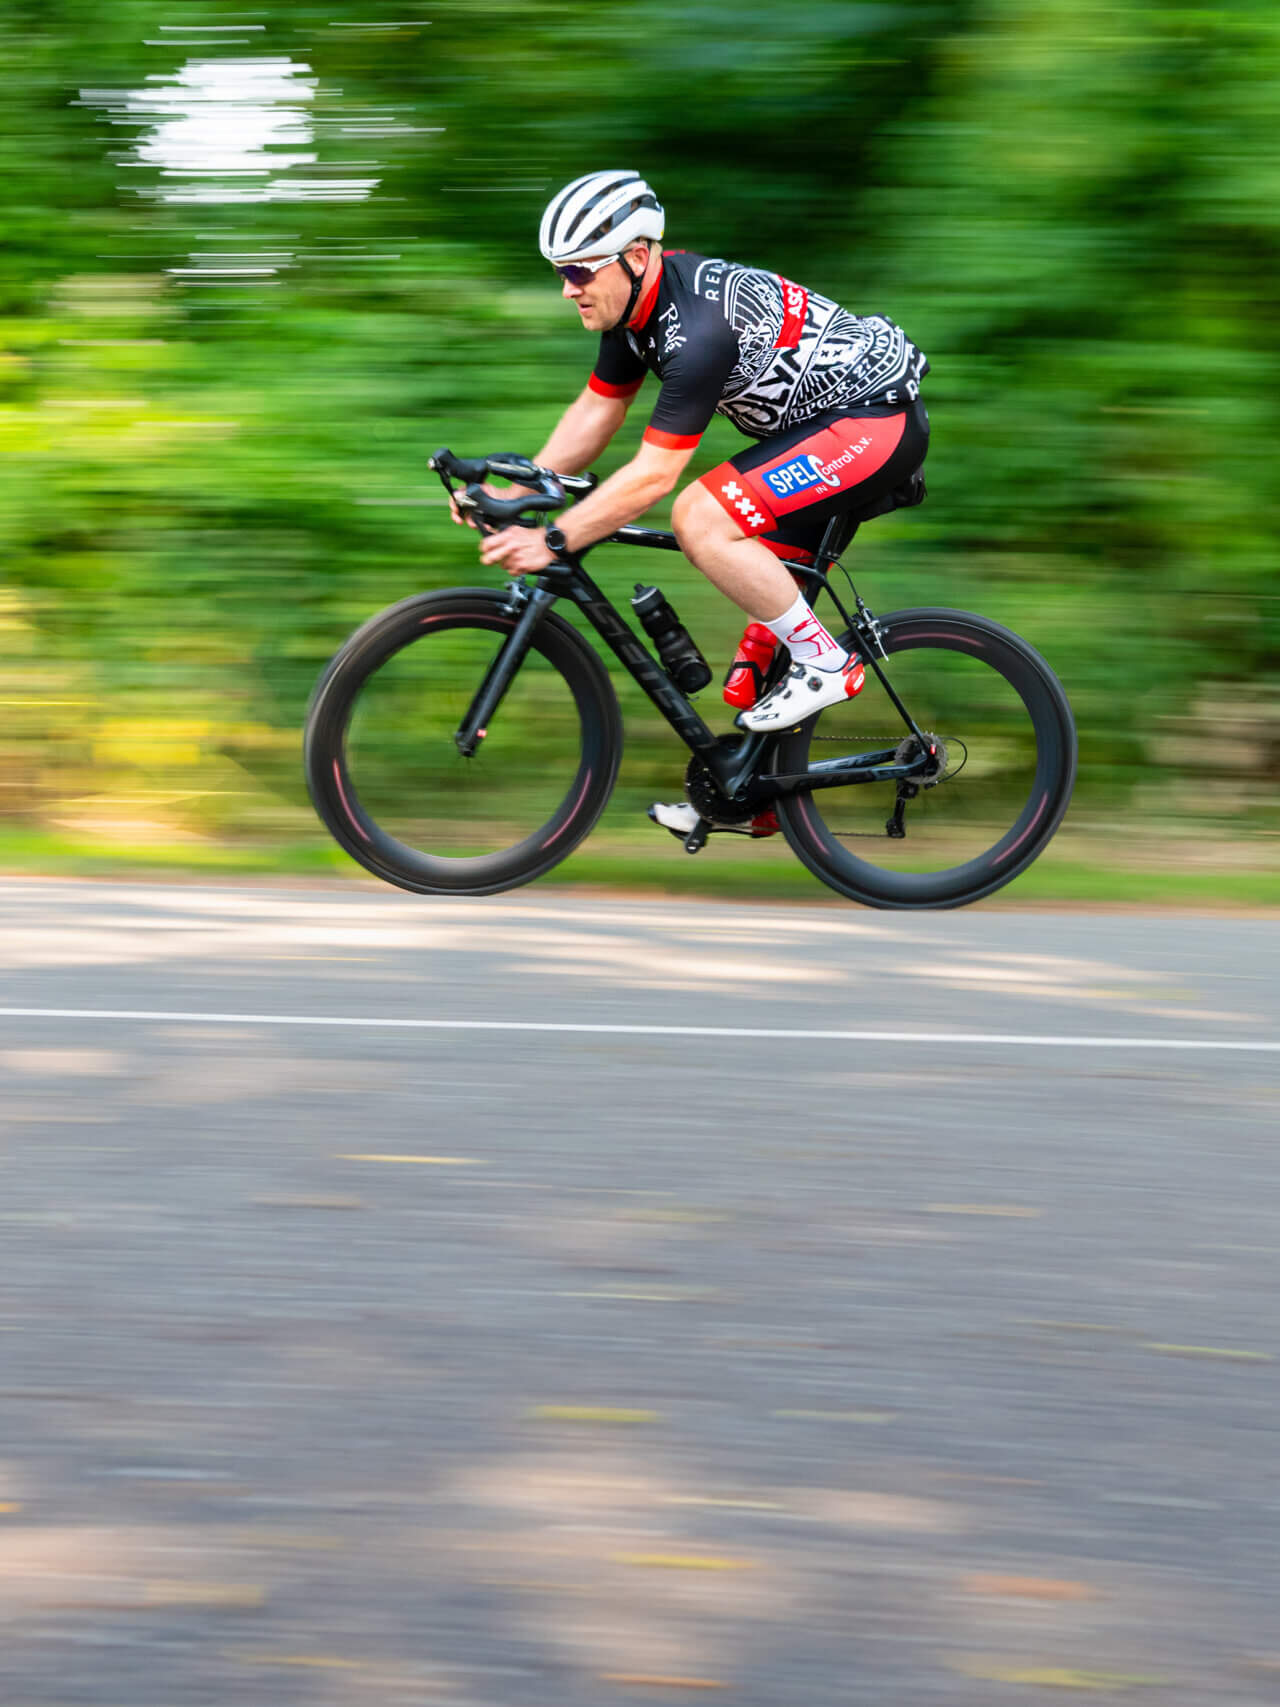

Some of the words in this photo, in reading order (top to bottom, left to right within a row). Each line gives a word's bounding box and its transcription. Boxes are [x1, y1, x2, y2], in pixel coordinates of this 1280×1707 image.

[786, 287, 804, 319] ASC
[721, 295, 830, 426] OLYMPI
[852, 358, 871, 379] 27
[769, 461, 818, 493] SPEL
[849, 436, 872, 454] b.v.
[815, 484, 828, 494] IN
